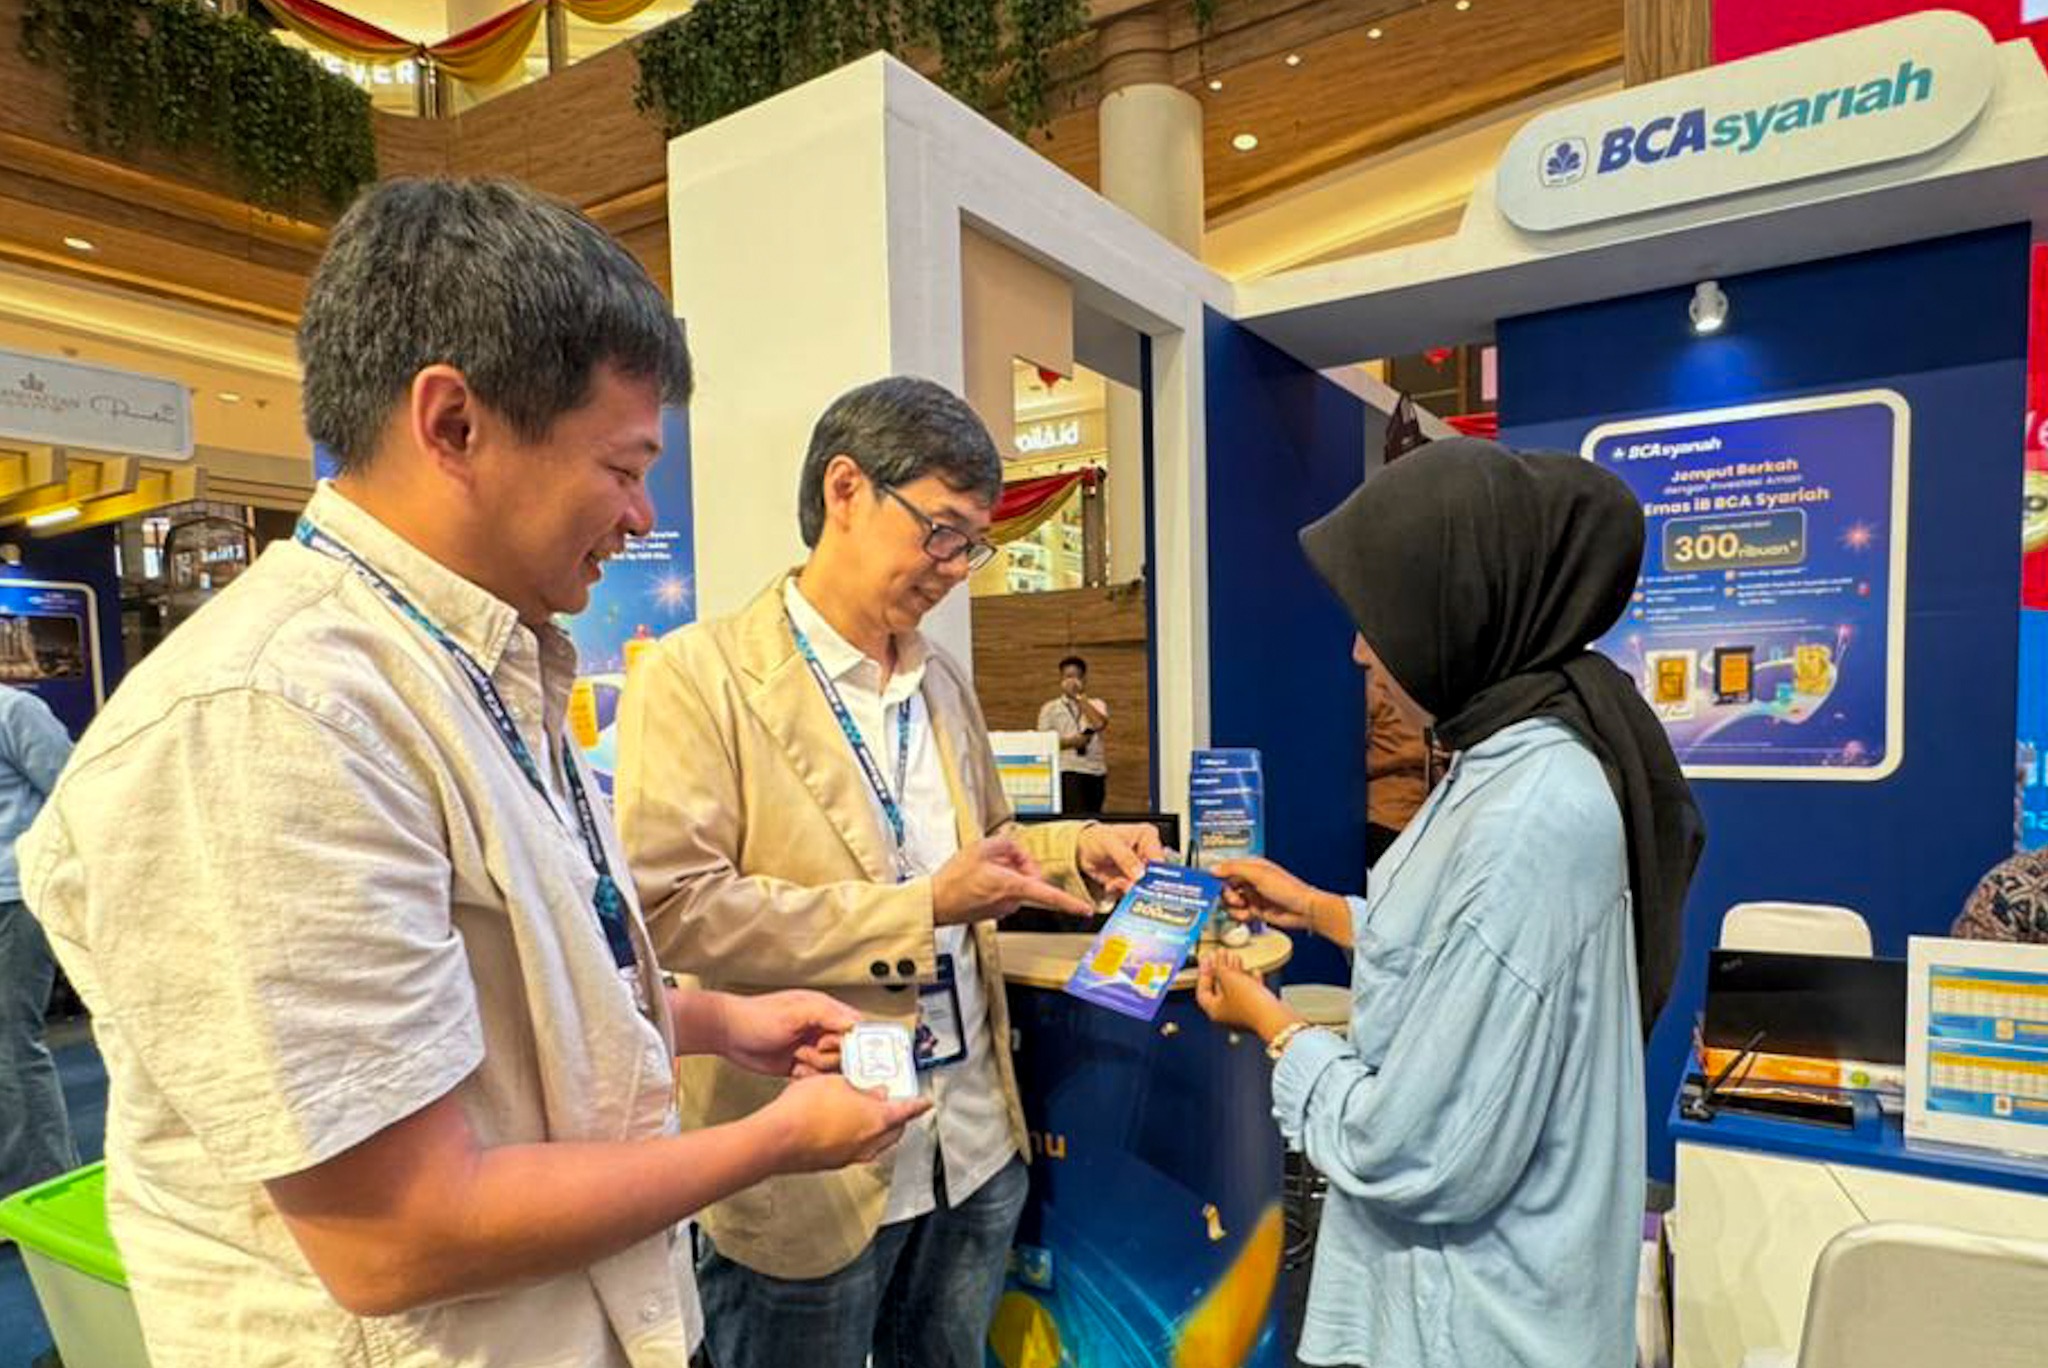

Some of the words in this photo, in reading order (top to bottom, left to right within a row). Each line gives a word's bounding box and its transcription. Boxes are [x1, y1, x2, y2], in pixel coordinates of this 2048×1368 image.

[1598, 61, 1933, 174] BCAsyariah
[1671, 464, 1734, 483] Jemput
[1736, 458, 1799, 476] Berkah
[1643, 501, 1691, 516] Emas
[1714, 492, 1753, 510] BCA
[1755, 486, 1831, 508] Syariah
[1663, 483, 1708, 496] dengan
